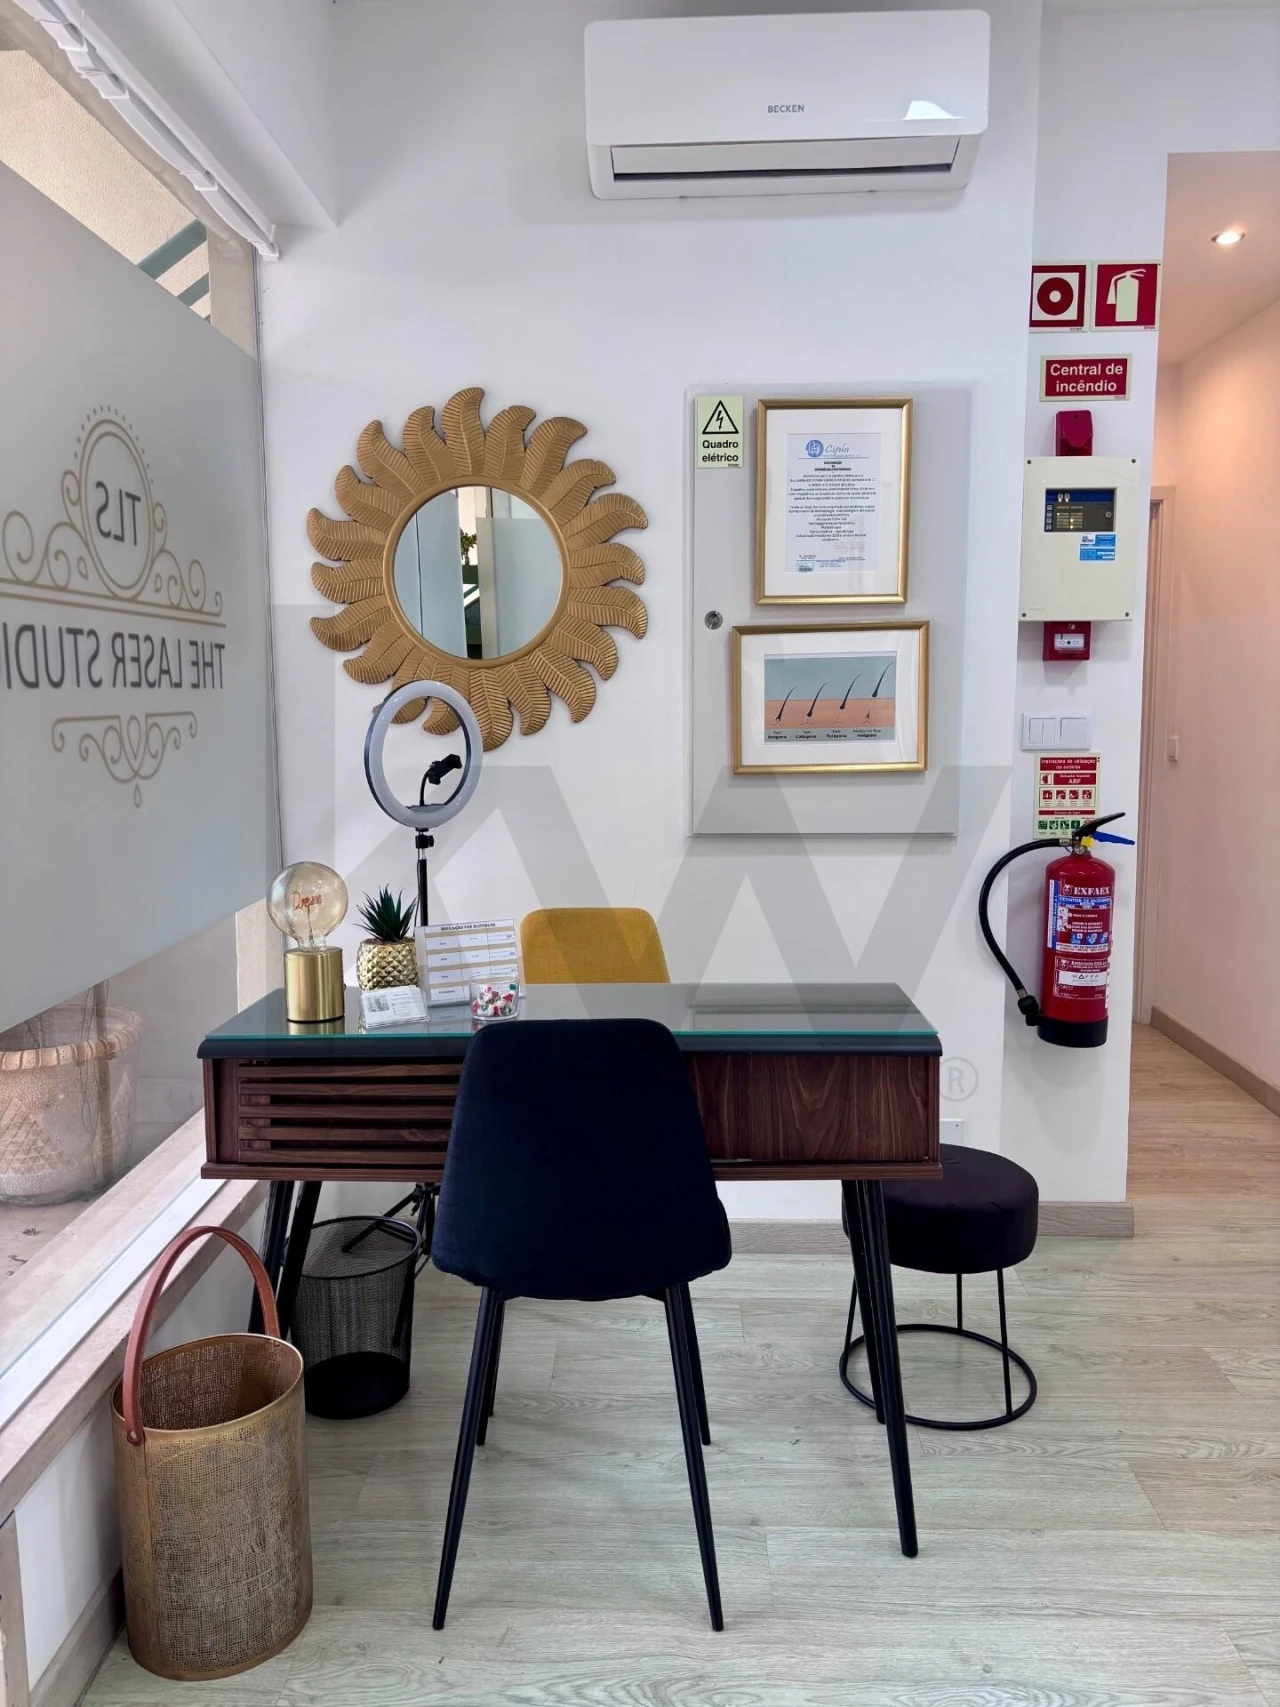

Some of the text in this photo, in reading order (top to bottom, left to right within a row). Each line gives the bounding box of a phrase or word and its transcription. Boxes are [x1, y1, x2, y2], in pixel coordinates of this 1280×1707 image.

[767, 104, 805, 114] BECKEN
[1050, 363, 1124, 376] Central de
[1056, 379, 1117, 392] incêndio
[702, 440, 739, 449] Quadro
[702, 453, 739, 462] elétrico
